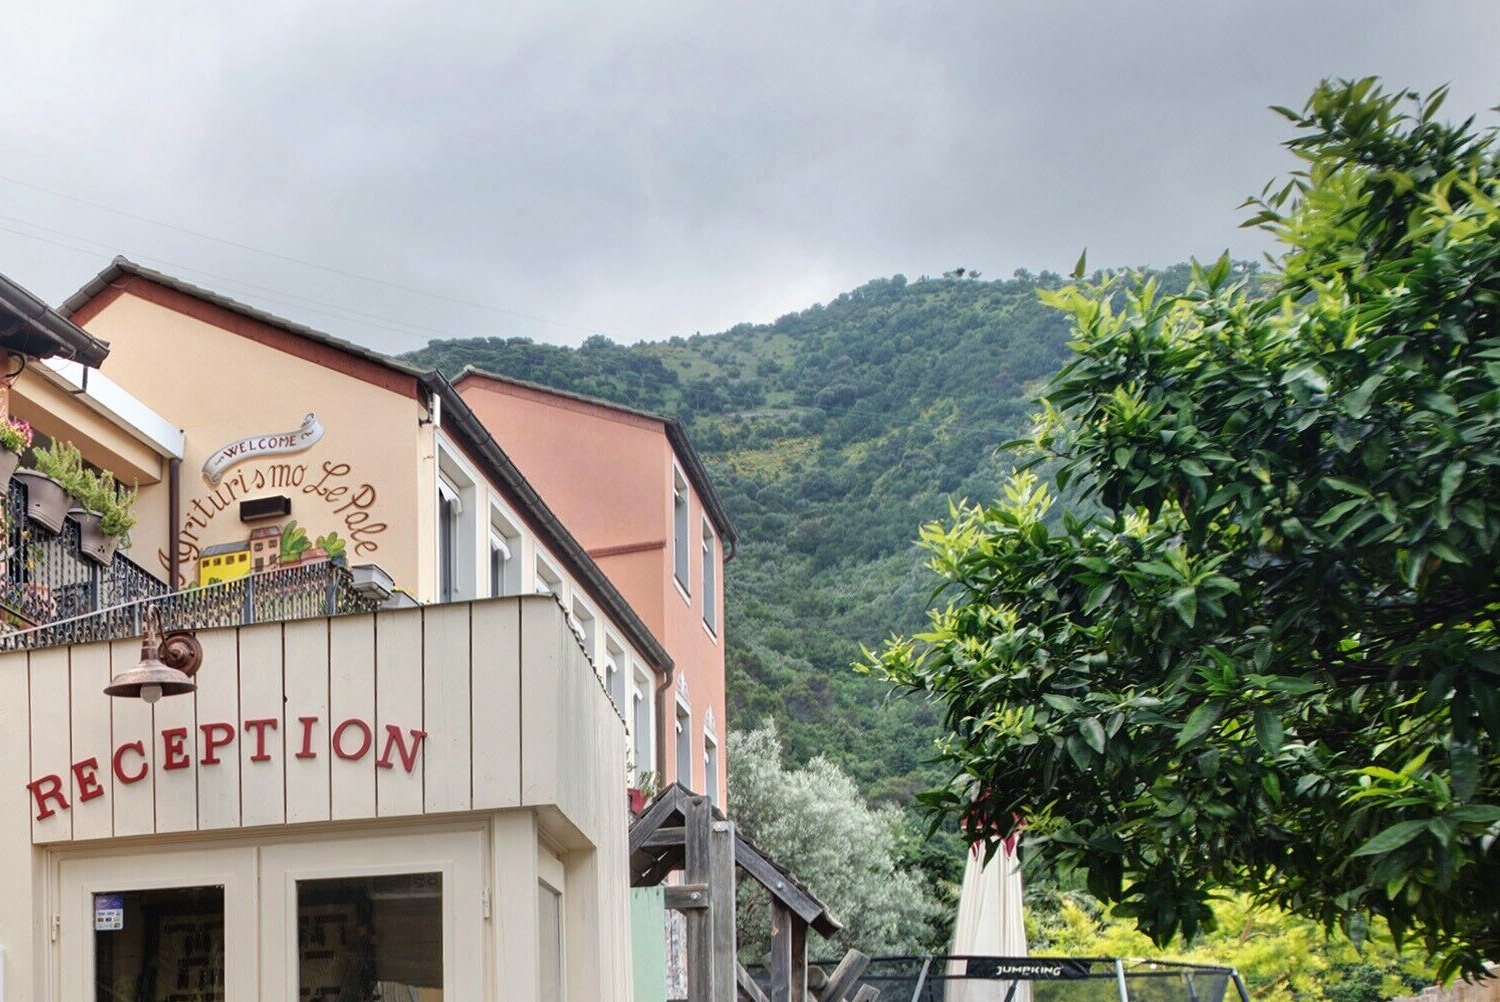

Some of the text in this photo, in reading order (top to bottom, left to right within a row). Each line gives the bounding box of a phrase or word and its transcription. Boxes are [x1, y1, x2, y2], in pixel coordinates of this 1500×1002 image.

[223, 434, 297, 459] WELCOME
[302, 460, 351, 503] Le
[333, 483, 388, 558] Pale
[26, 716, 428, 822] RECEPTION
[996, 965, 1062, 976] JUMPKING
